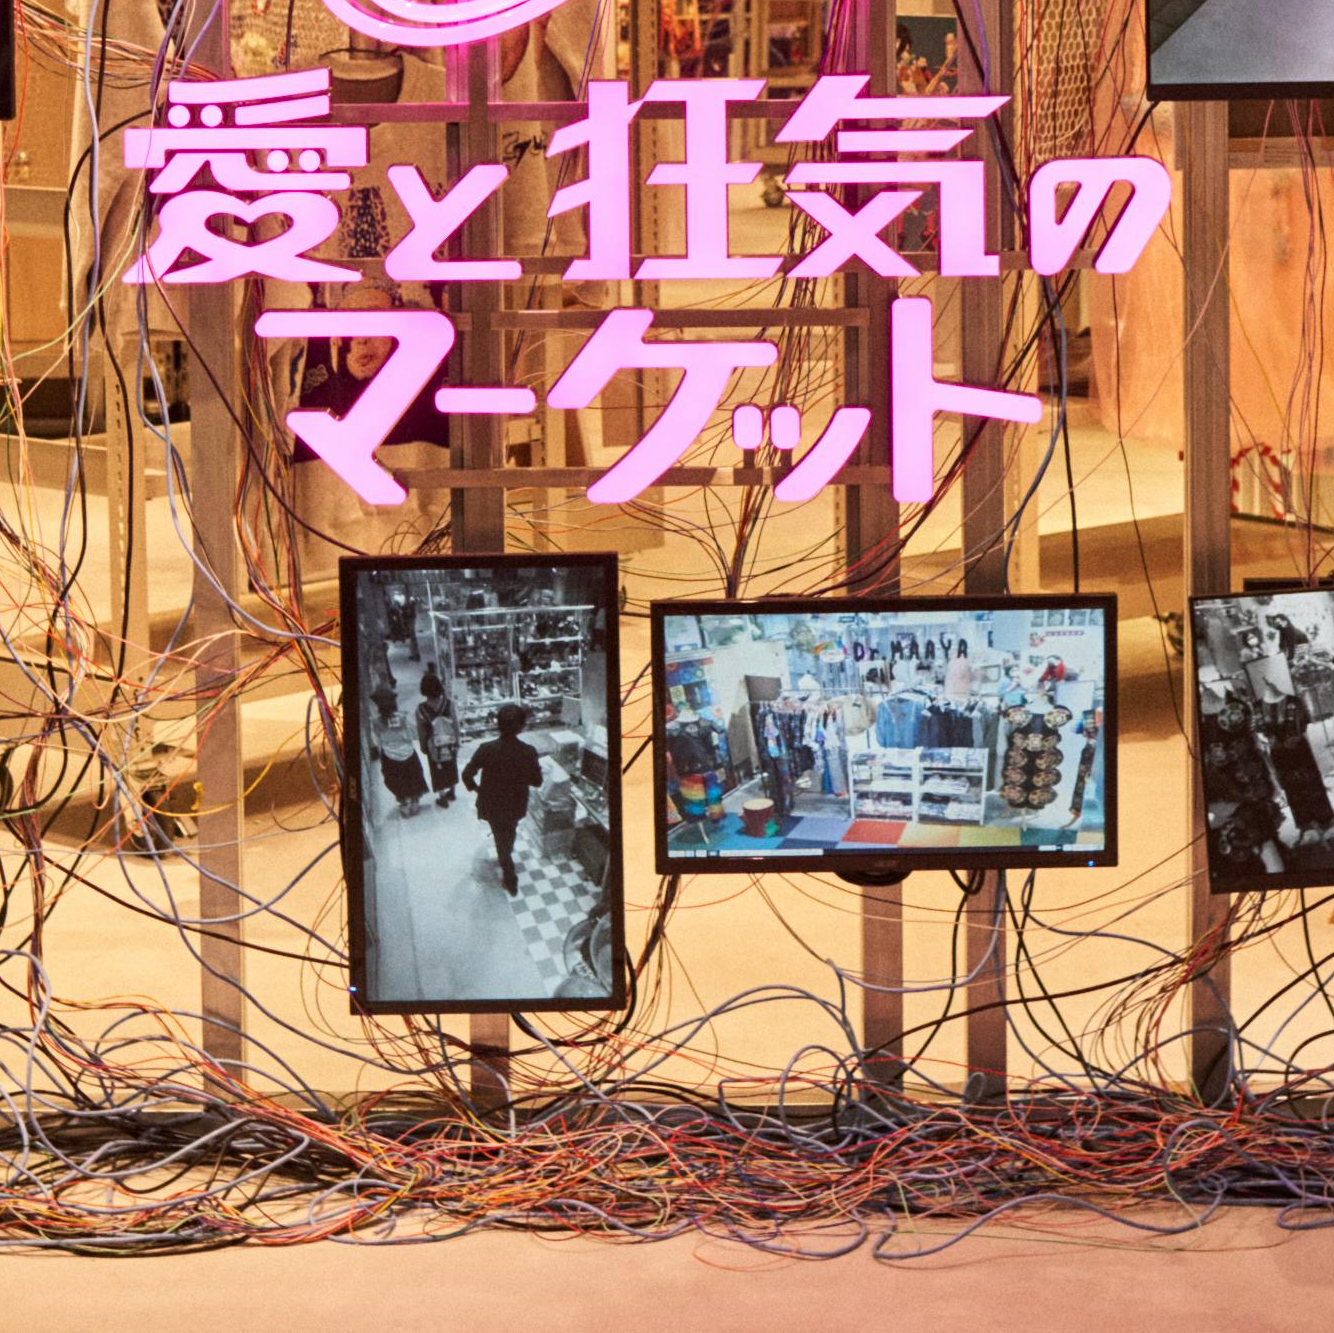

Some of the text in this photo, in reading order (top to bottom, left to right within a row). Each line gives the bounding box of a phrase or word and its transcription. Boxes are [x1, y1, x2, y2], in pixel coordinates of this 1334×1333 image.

[123, 69, 1172, 283] 愛と狂気の
[255, 298, 1042, 504] マーケット
